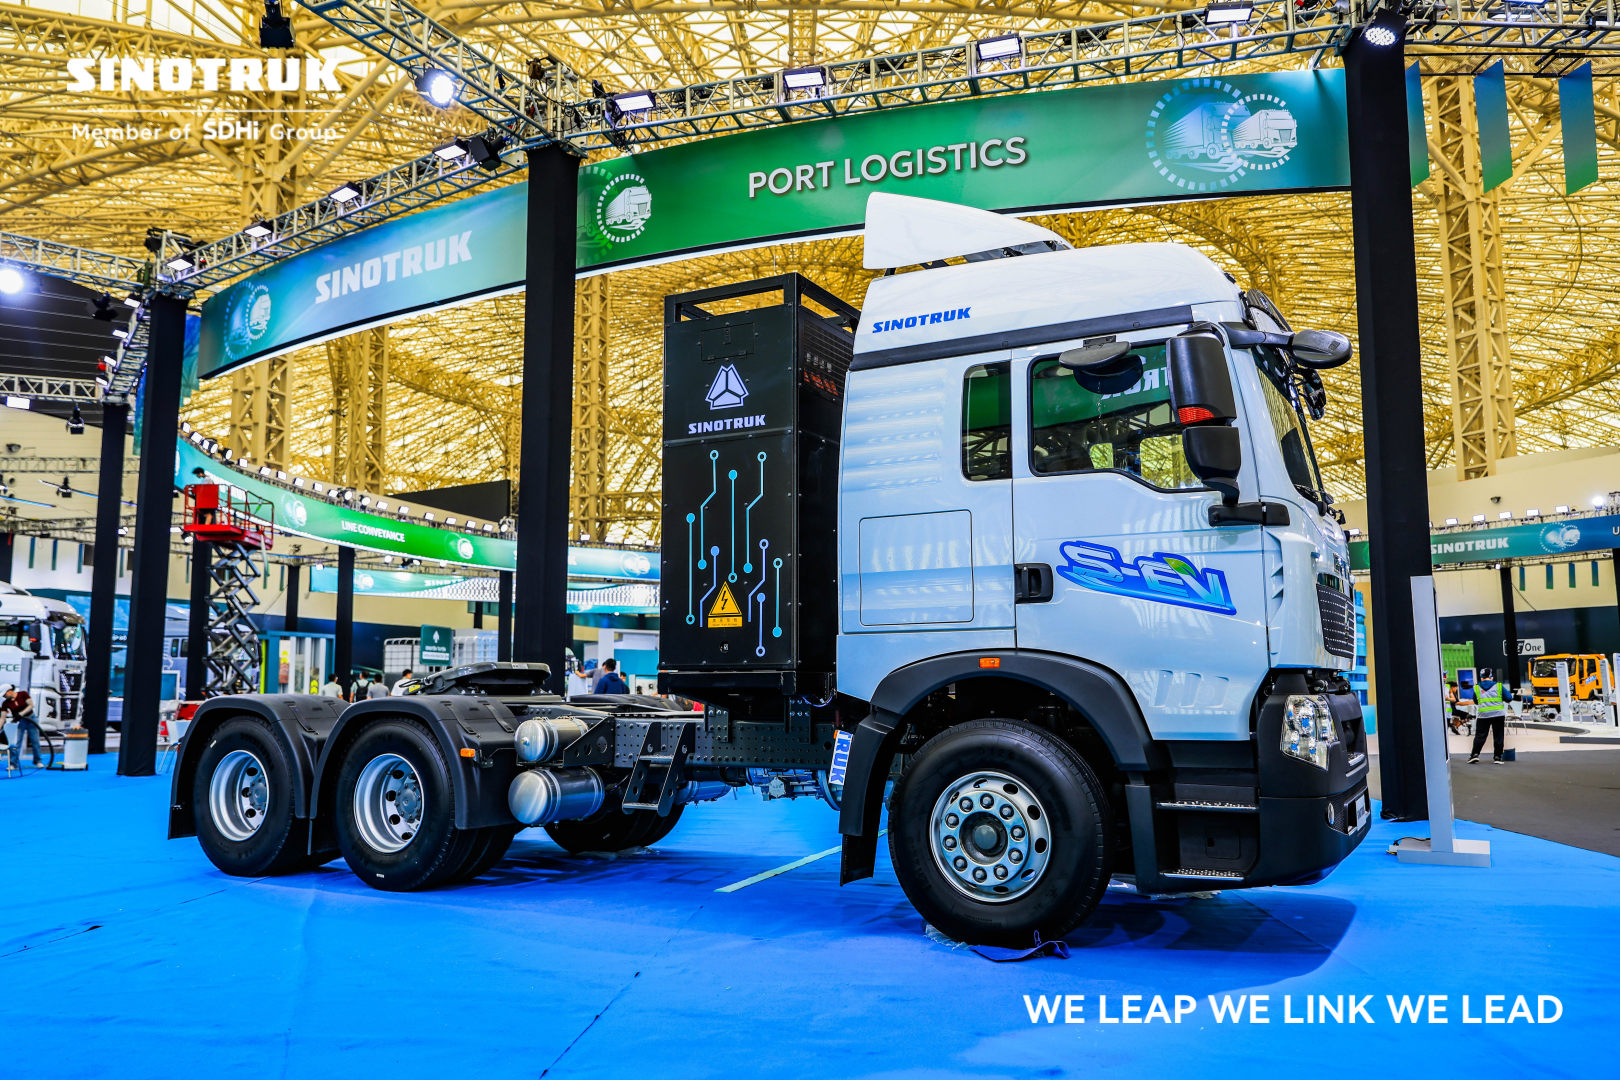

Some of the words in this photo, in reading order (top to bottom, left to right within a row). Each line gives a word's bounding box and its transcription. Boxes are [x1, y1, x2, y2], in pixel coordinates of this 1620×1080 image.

[748, 160, 835, 199] PORT
[843, 136, 1027, 185] LOGISTICS
[315, 230, 473, 305] SINOTRUK
[872, 306, 972, 334] SINOTRUK
[688, 414, 766, 435] SINOTRUK
[341, 520, 358, 533] LINE
[357, 523, 406, 543] CONVEYANCE
[1431, 537, 1510, 555] SINOTRUK
[1057, 541, 1236, 614] S-EV
[1524, 642, 1542, 652] One
